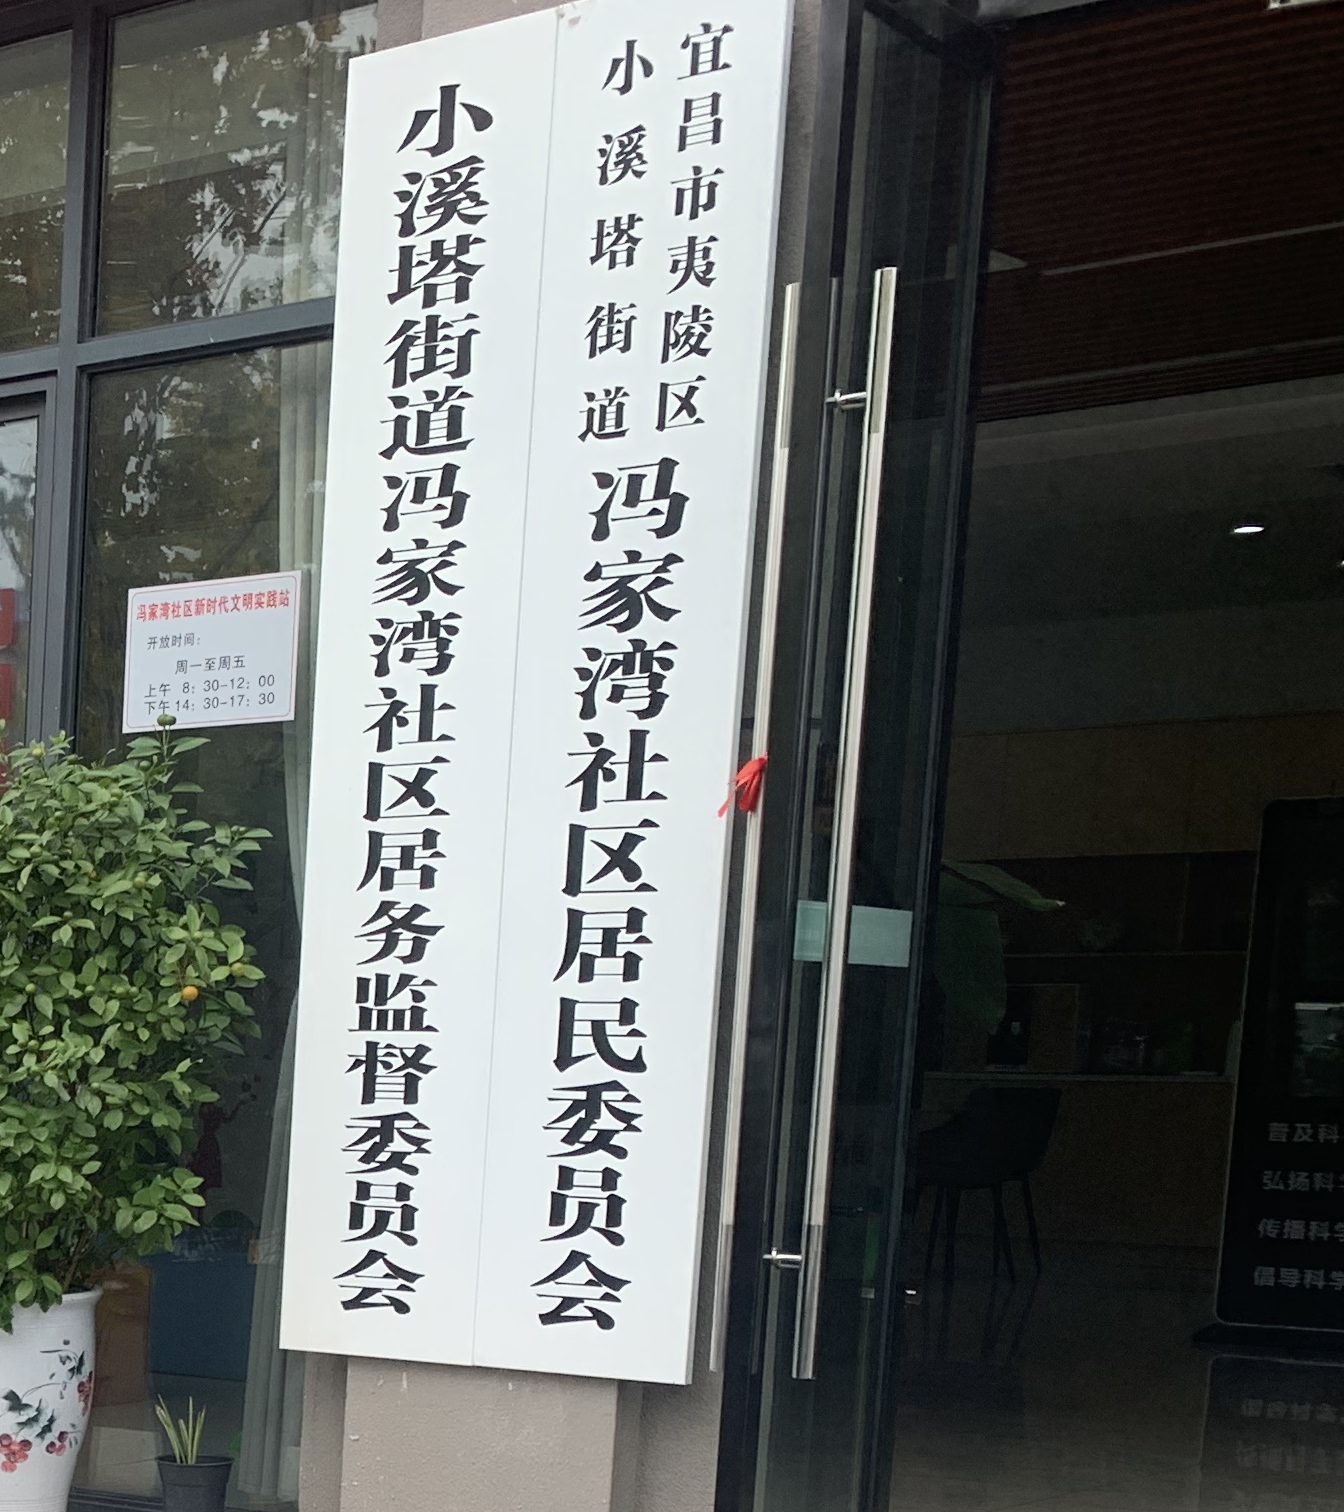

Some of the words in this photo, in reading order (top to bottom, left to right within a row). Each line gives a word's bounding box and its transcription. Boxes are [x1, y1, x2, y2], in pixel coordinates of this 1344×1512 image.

[577, 38, 654, 443] 小溪塔街道
[655, 21, 734, 433] 宜昌市夷陵区
[137, 588, 291, 622] 冯家湾社区新时代文明实践站
[146, 632, 201, 650] 开放时间：
[174, 655, 246, 675] 周一至周五
[332, 83, 494, 1316] 小溪塔街道冯家湾社区居务监督委员会
[530, 456, 690, 1331] 冯家湾社区居民委员会
[1261, 1170, 1344, 1192] 弘扬科
